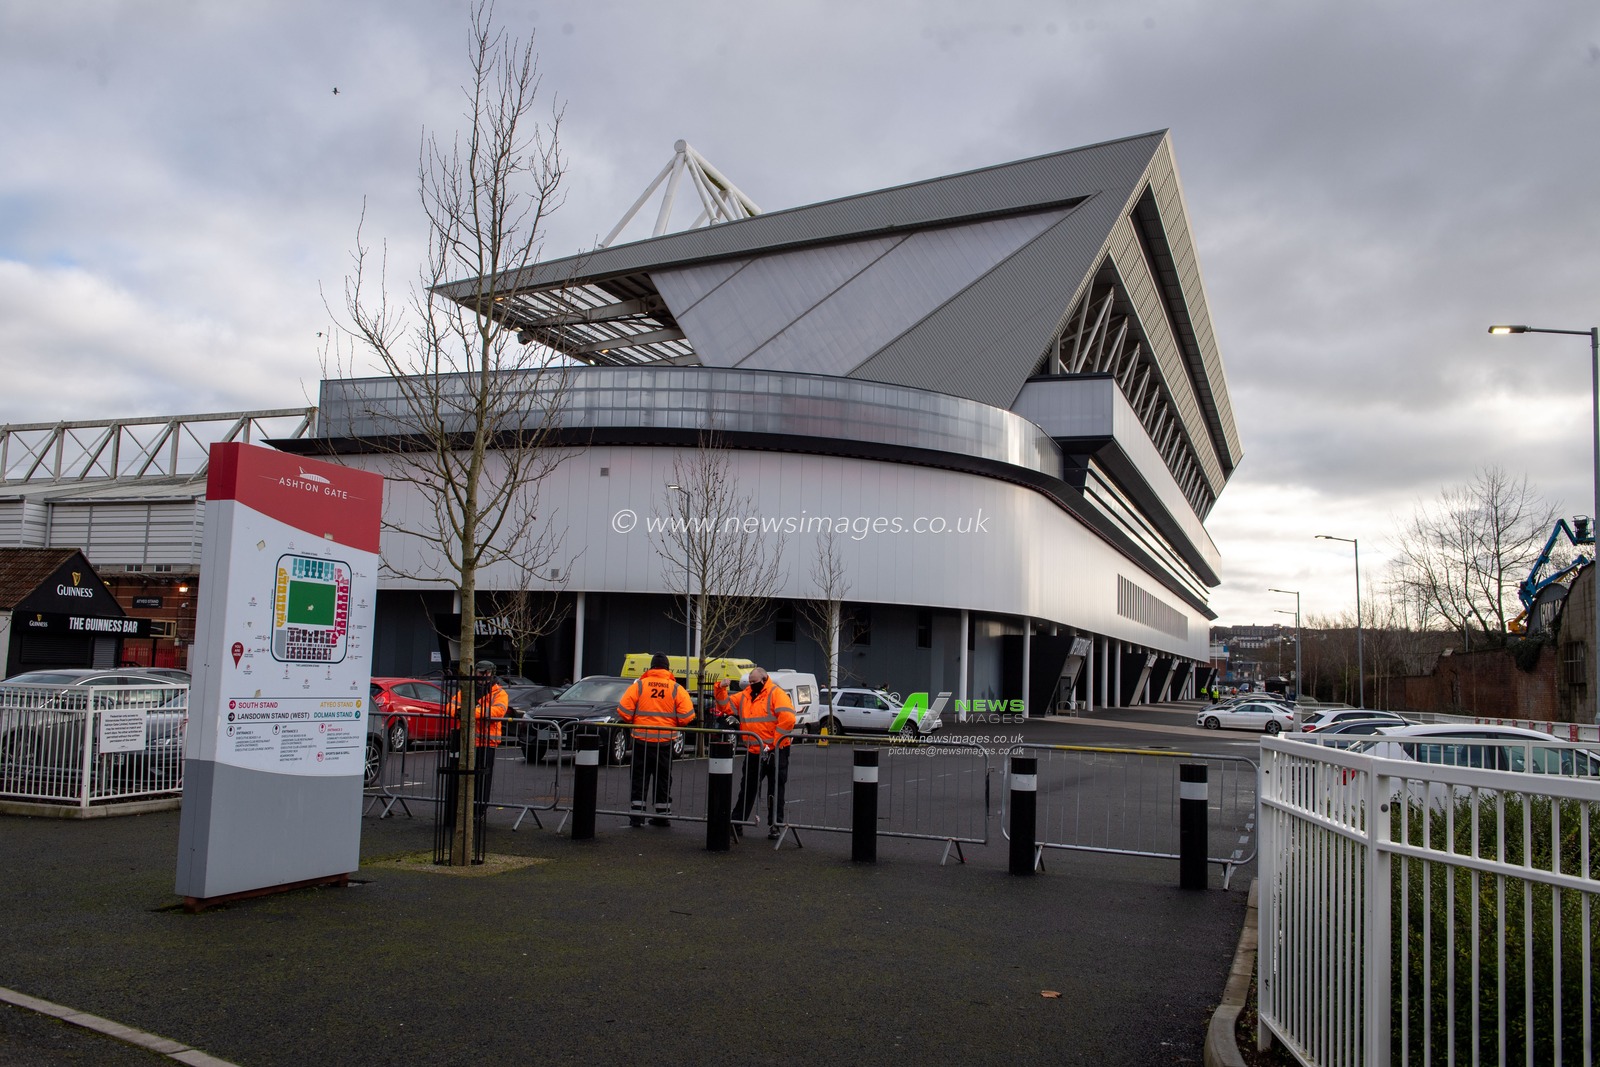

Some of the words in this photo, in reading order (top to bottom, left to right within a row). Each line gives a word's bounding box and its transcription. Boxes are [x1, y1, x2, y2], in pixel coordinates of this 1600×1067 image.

[279, 477, 318, 492] ASHTON
[324, 487, 348, 499] GATE
[57, 584, 93, 598] GUINNESS
[29, 620, 48, 628] GUINNESS
[69, 617, 84, 630] THE
[85, 618, 122, 632] GUINNESS
[122, 620, 138, 633] BAR
[650, 689, 665, 699] 24
[290, 712, 310, 720] (WEST)
